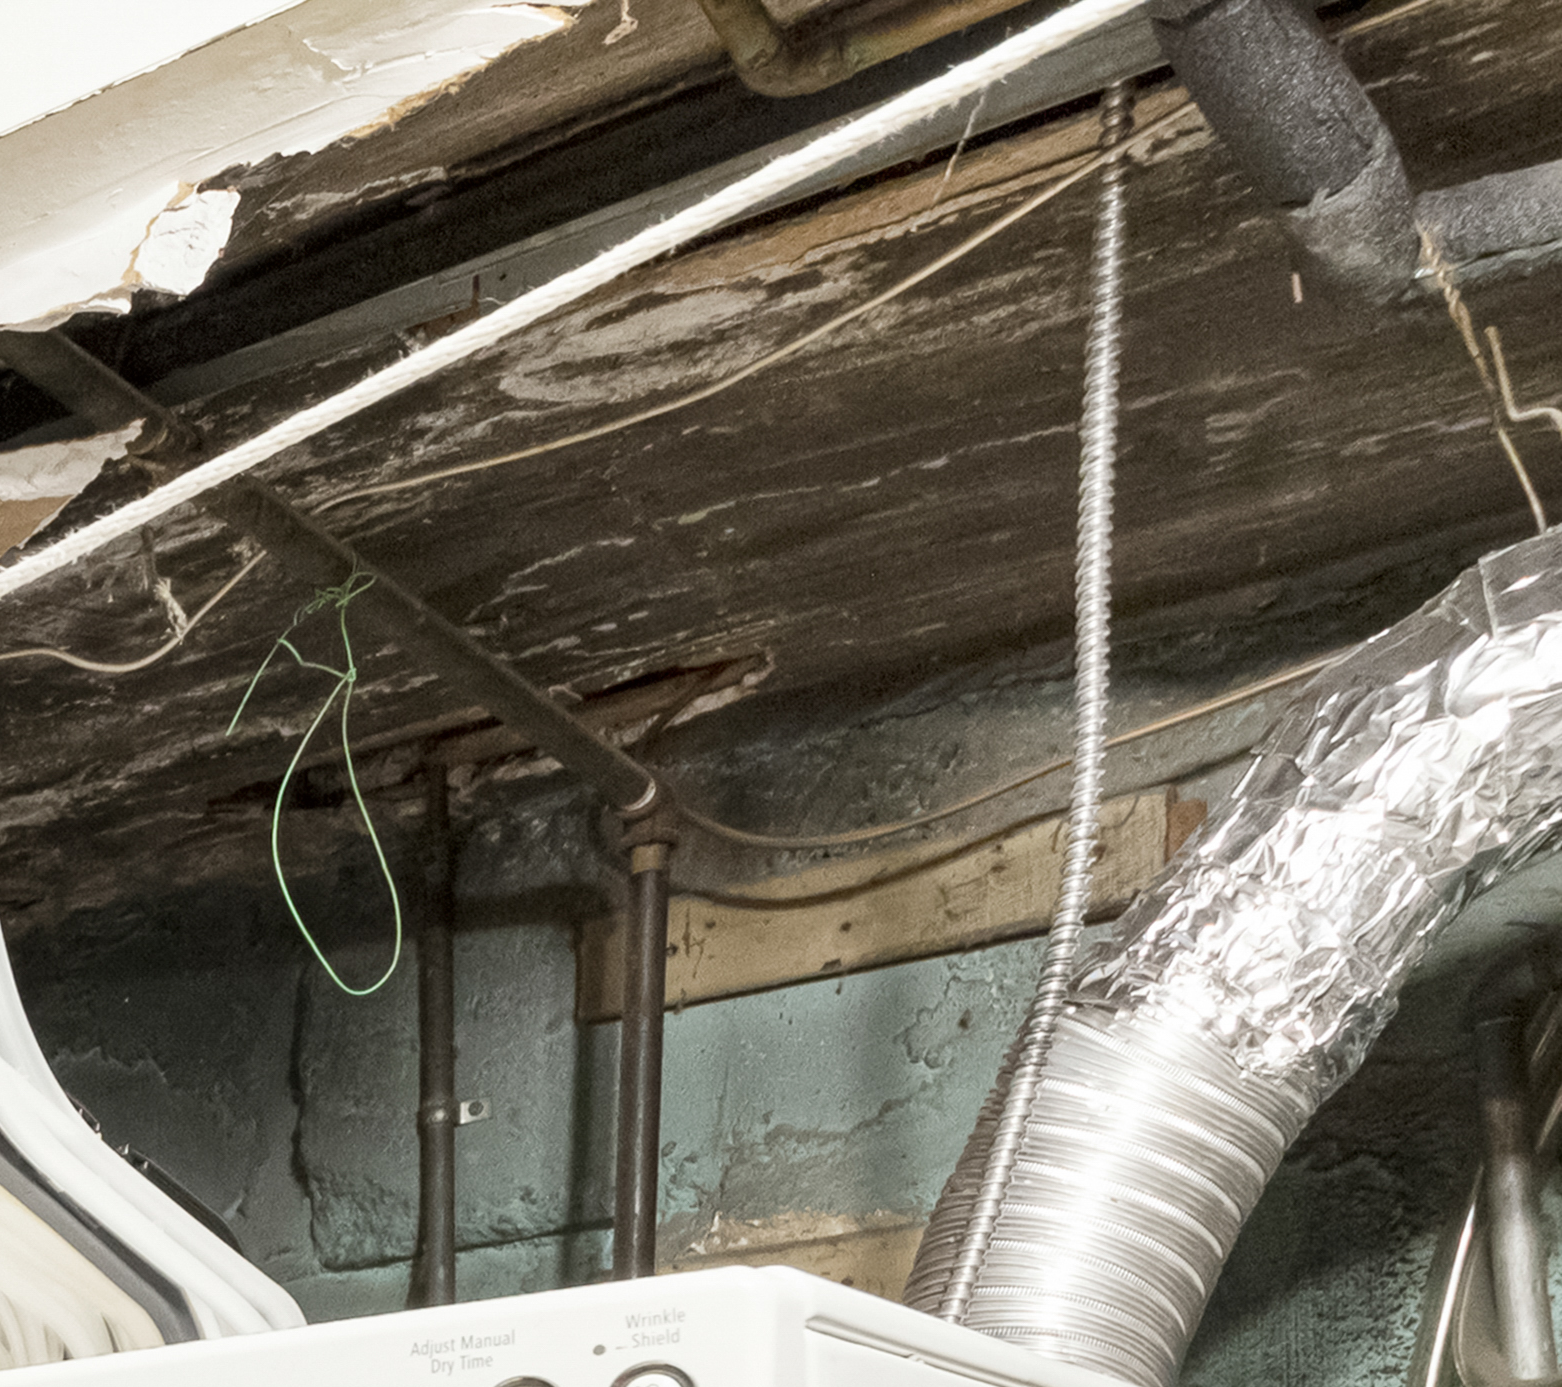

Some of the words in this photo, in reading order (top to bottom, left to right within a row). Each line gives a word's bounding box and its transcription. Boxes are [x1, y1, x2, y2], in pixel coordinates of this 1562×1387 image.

[625, 1308, 686, 1329] Wrinkle
[410, 1337, 456, 1358] Adjust
[460, 1329, 516, 1350] Manual
[631, 1329, 680, 1349] Shield
[430, 1358, 454, 1376] Dry
[460, 1354, 493, 1370] Time
